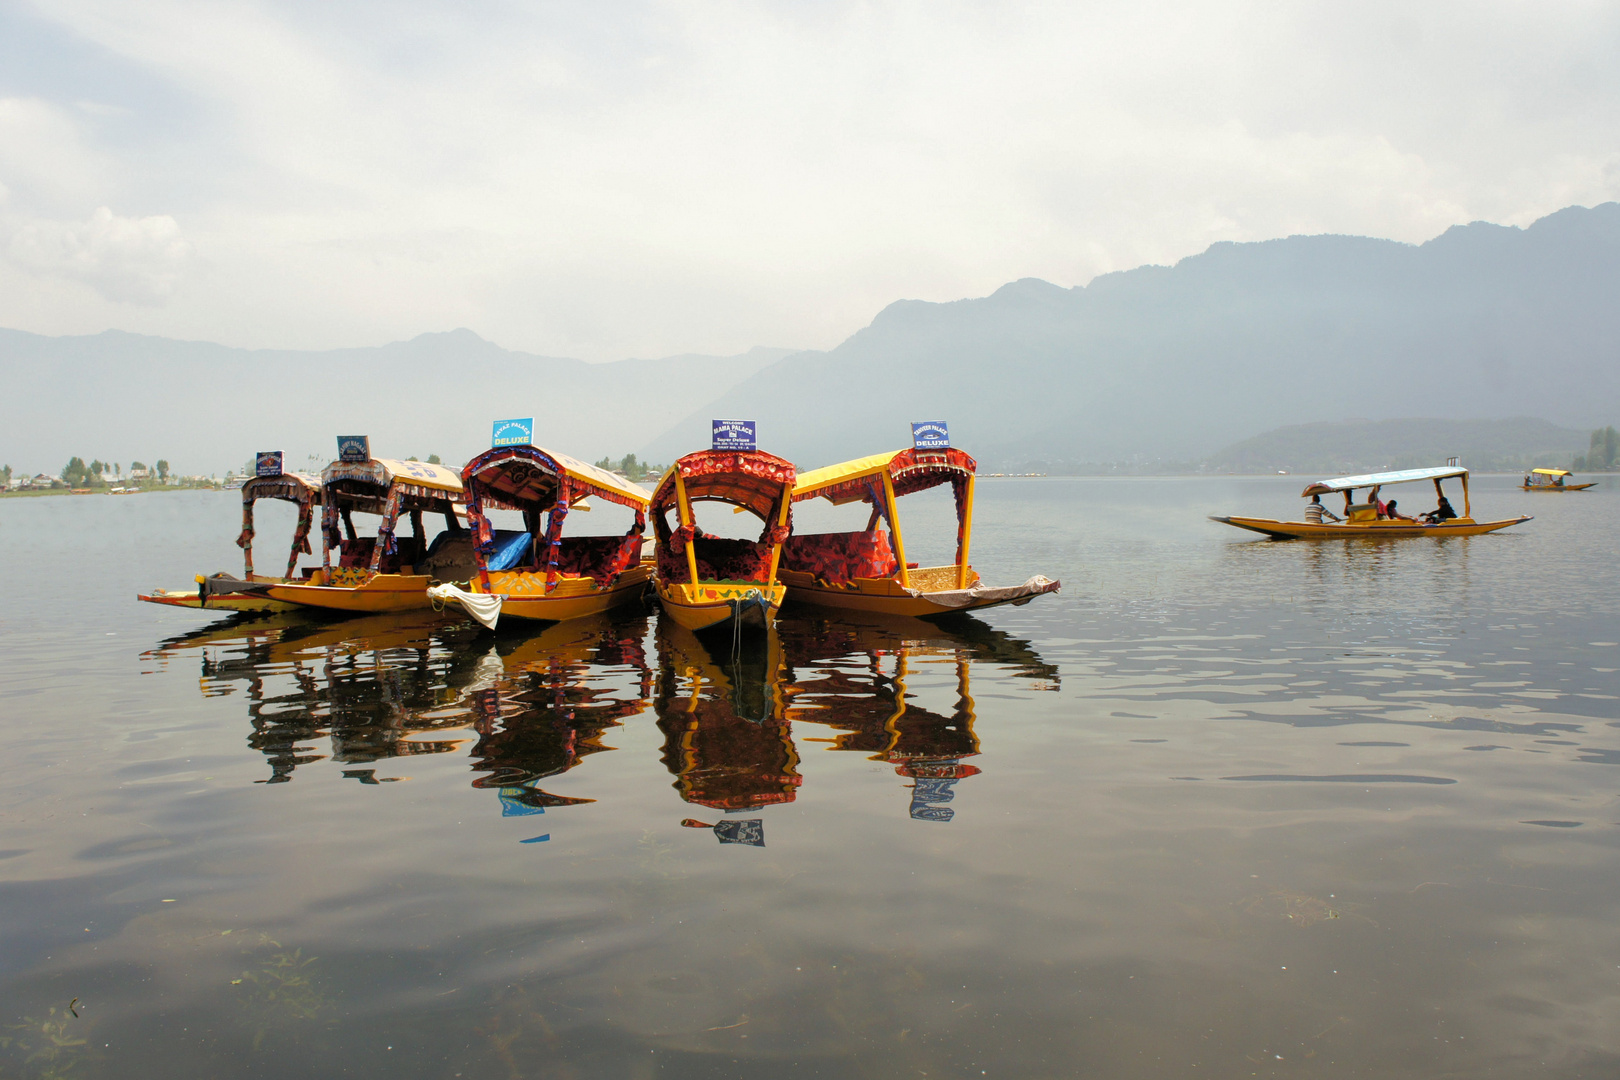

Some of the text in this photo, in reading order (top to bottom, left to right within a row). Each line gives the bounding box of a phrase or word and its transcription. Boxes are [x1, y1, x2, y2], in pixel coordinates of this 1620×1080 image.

[511, 422, 530, 435] PALACE
[713, 424, 752, 435] MAMA PALACE
[932, 424, 947, 435] PALACE
[495, 436, 529, 445] DELUXE
